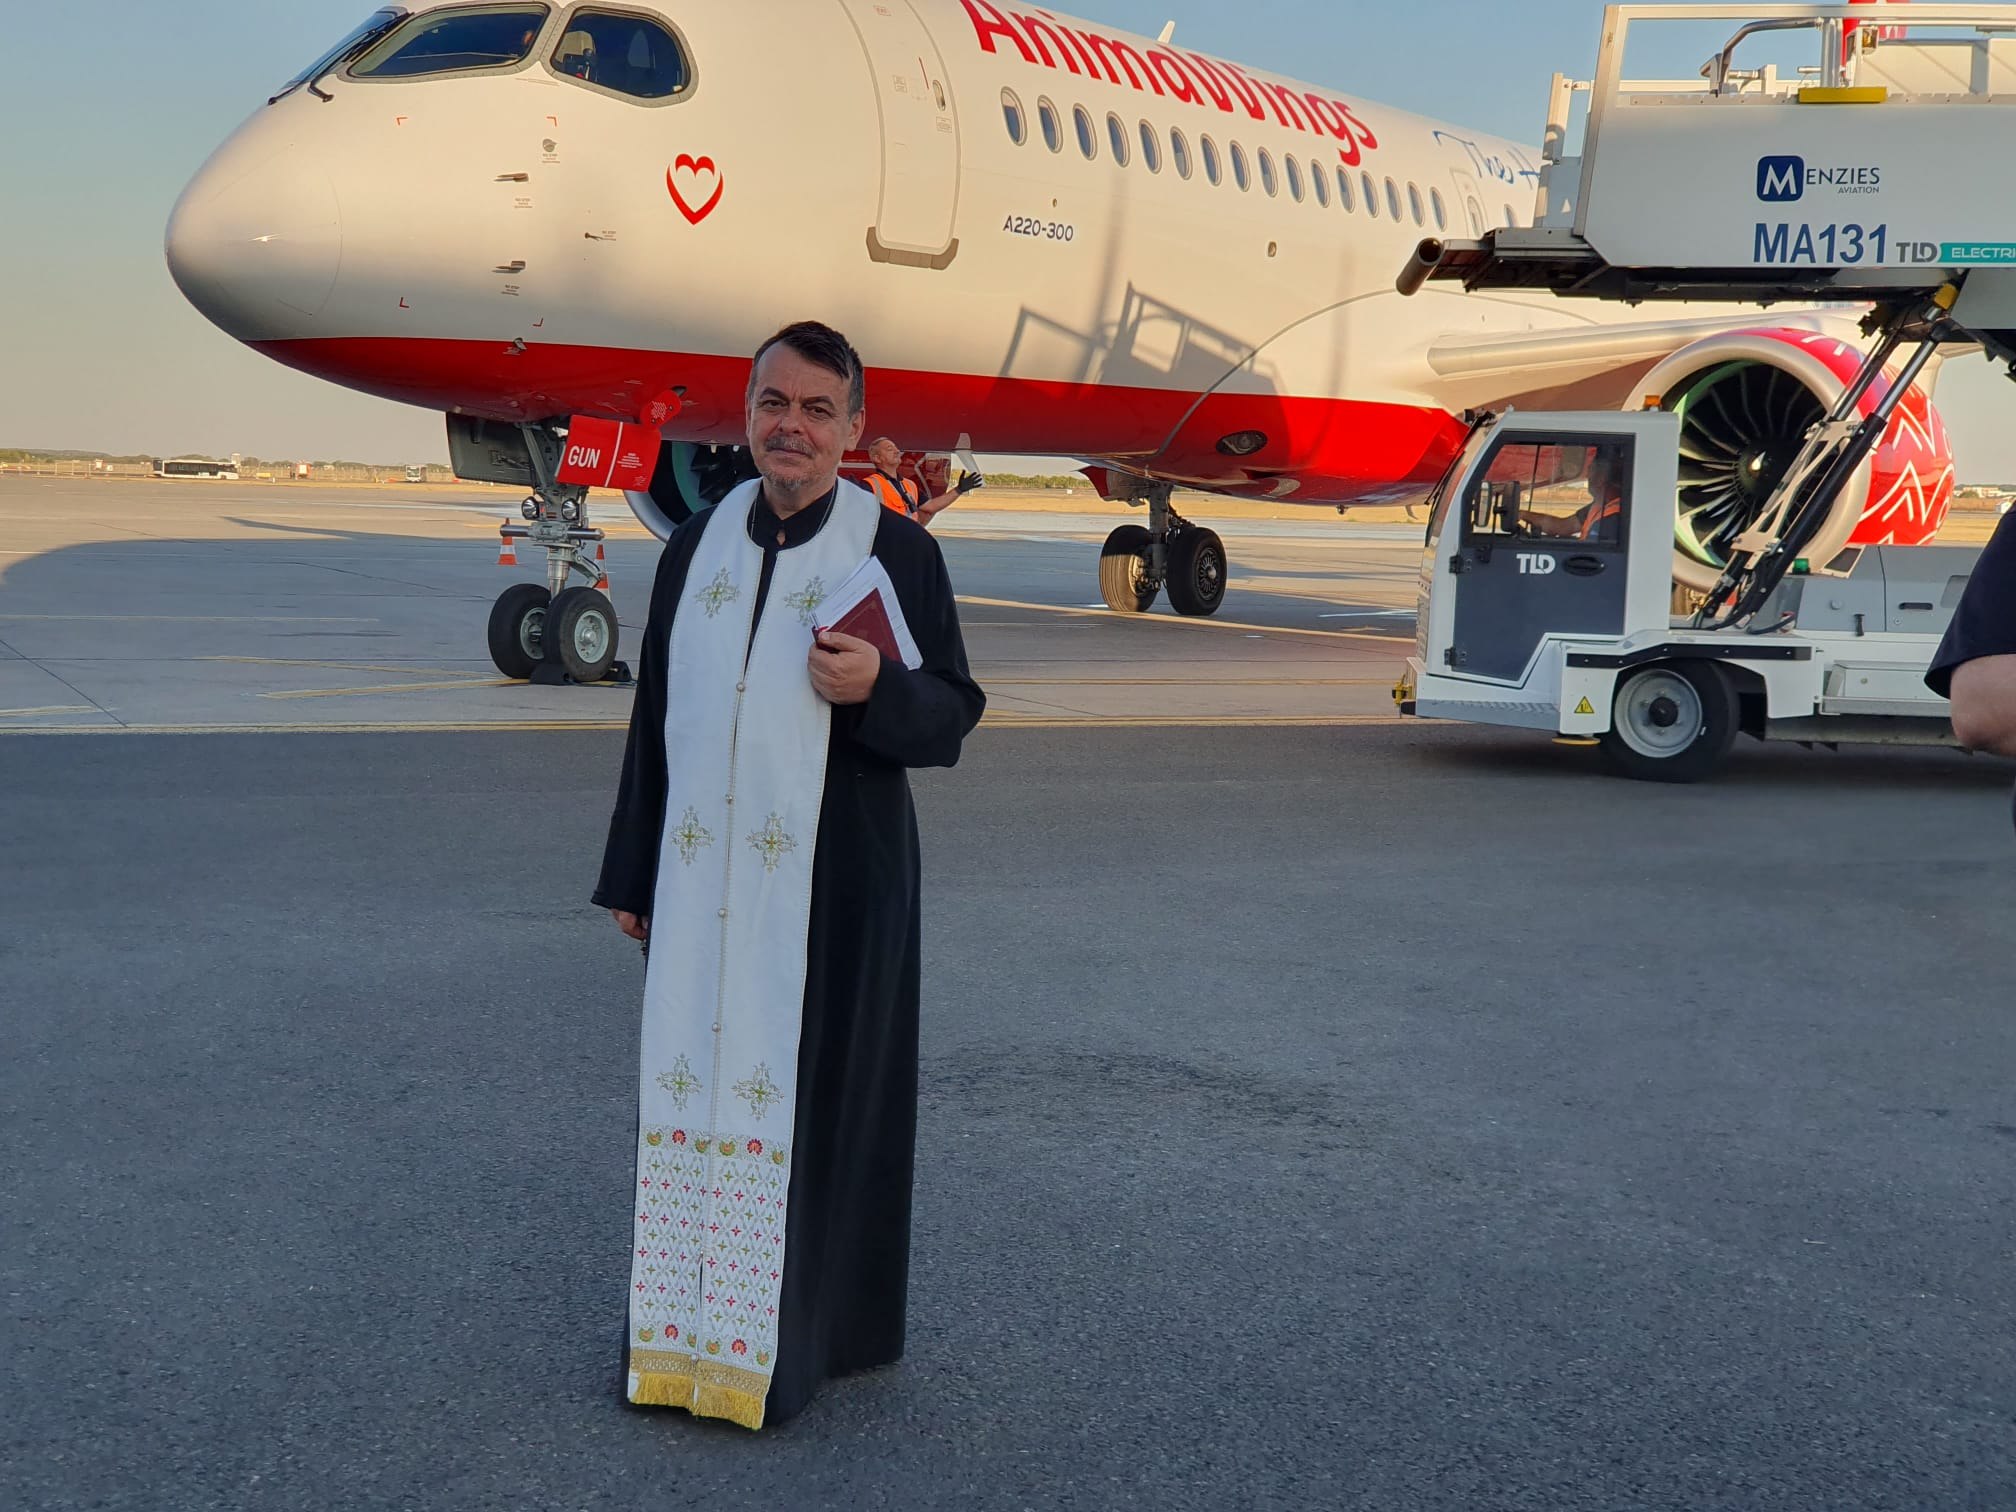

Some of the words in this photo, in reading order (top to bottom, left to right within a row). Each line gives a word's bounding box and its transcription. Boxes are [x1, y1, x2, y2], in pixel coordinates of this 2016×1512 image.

[1761, 162, 1880, 196] MENZIES
[1837, 186, 1880, 194] AVIATION
[1003, 215, 1074, 241] A220-300
[1753, 223, 1887, 263] MA131
[1895, 242, 1938, 263] TLD
[568, 445, 600, 469] GUN
[1516, 553, 1556, 575] TLD
